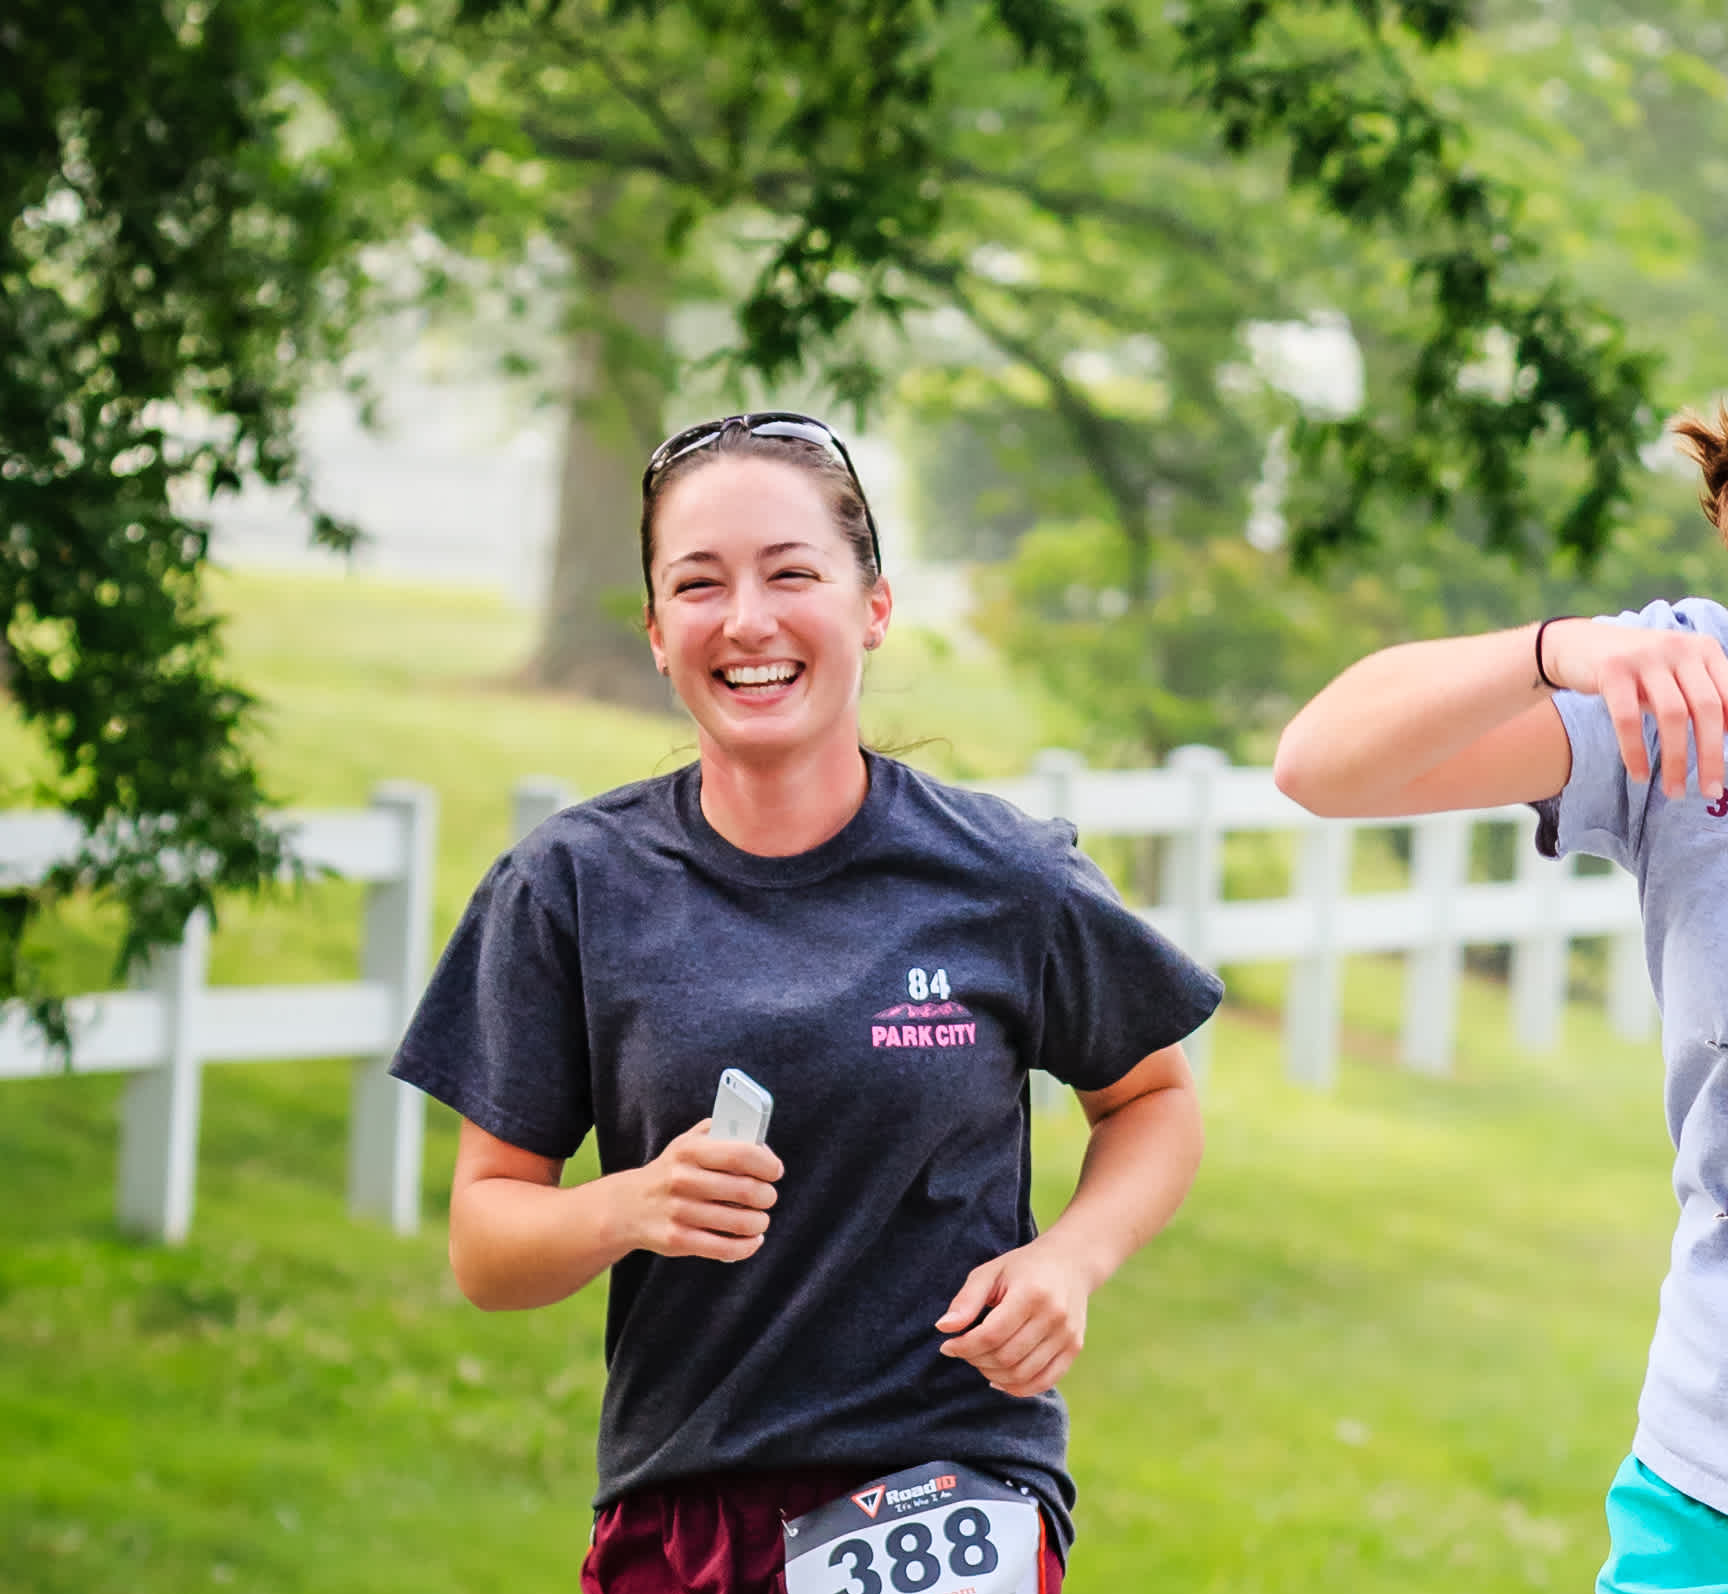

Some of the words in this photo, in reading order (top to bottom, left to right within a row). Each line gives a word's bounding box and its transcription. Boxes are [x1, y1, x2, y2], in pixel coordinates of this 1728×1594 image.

[907, 967, 951, 1000] 84
[871, 1024, 934, 1047] PARK
[935, 1022, 976, 1047] CITY
